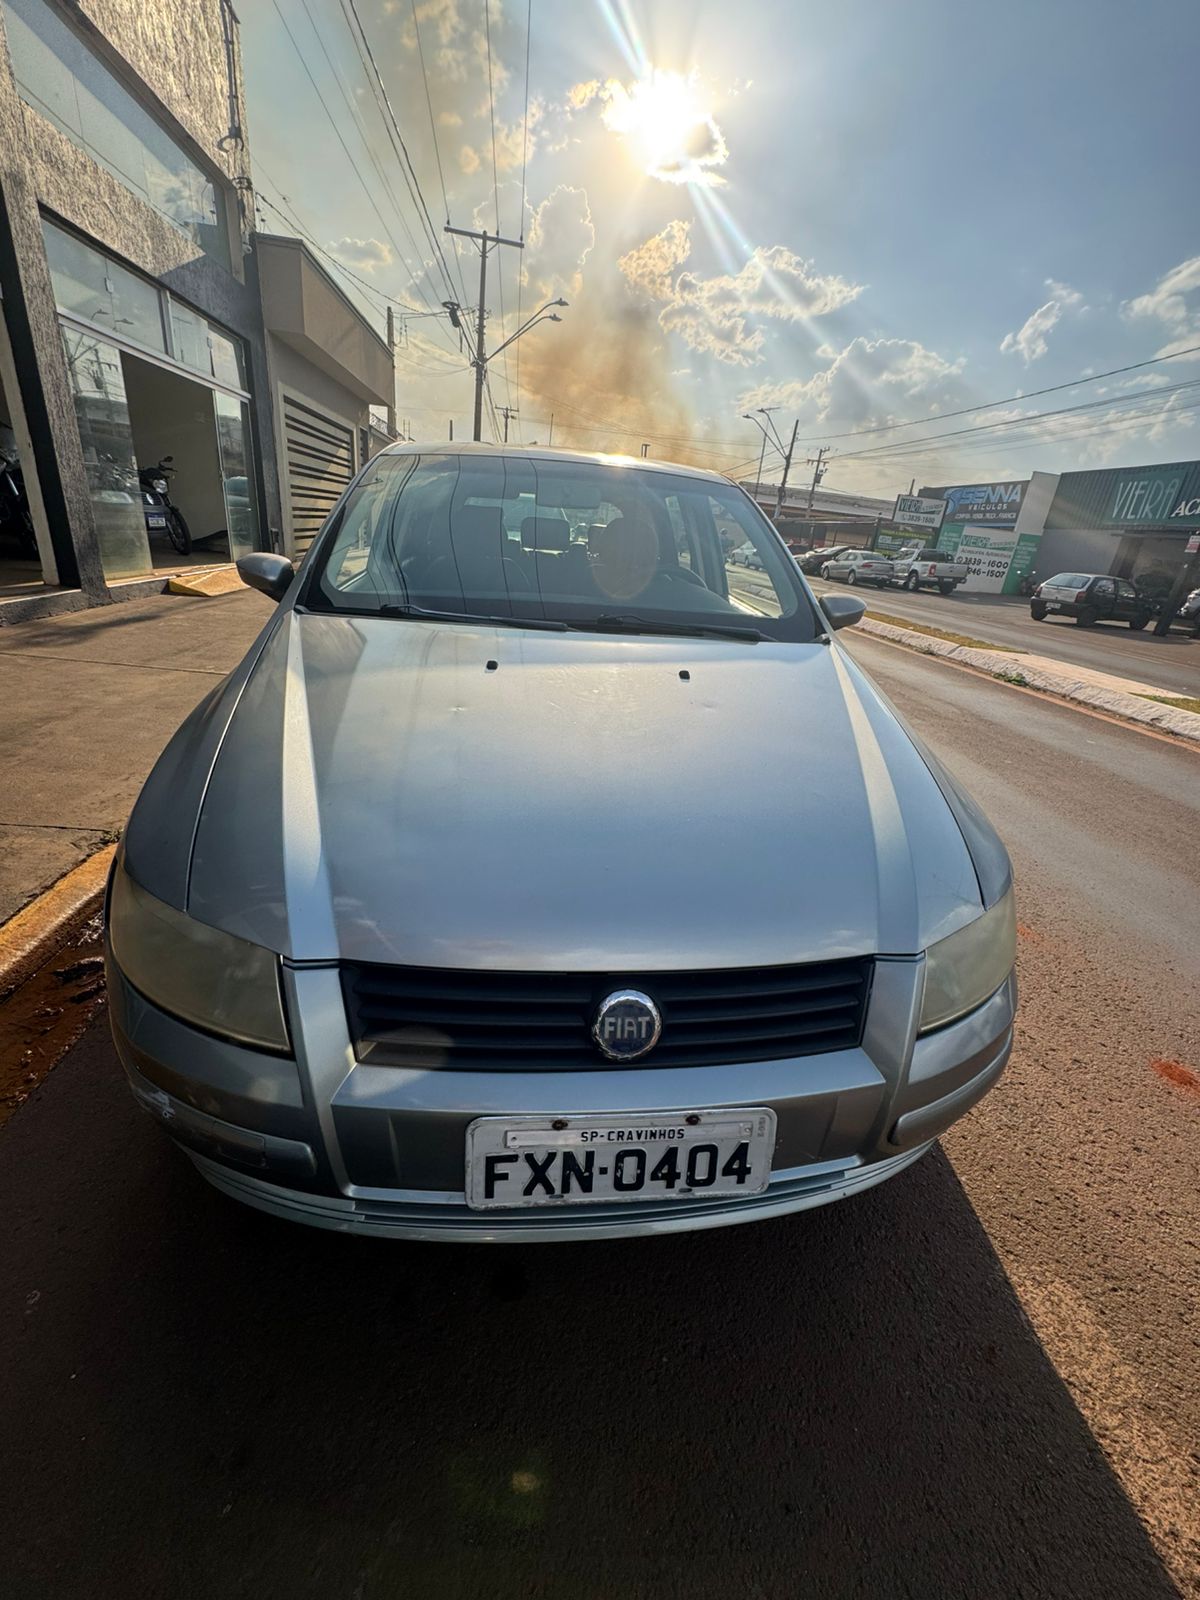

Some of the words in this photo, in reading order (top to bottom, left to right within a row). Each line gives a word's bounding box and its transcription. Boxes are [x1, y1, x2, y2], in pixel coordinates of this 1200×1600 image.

[960, 485, 1022, 504] SENNA
[1112, 478, 1180, 519] VIEIRA
[604, 1016, 650, 1039] FIAT
[581, 1128, 685, 1142] SP-CRAVINHOS
[484, 1140, 752, 1199] FXN-0404
